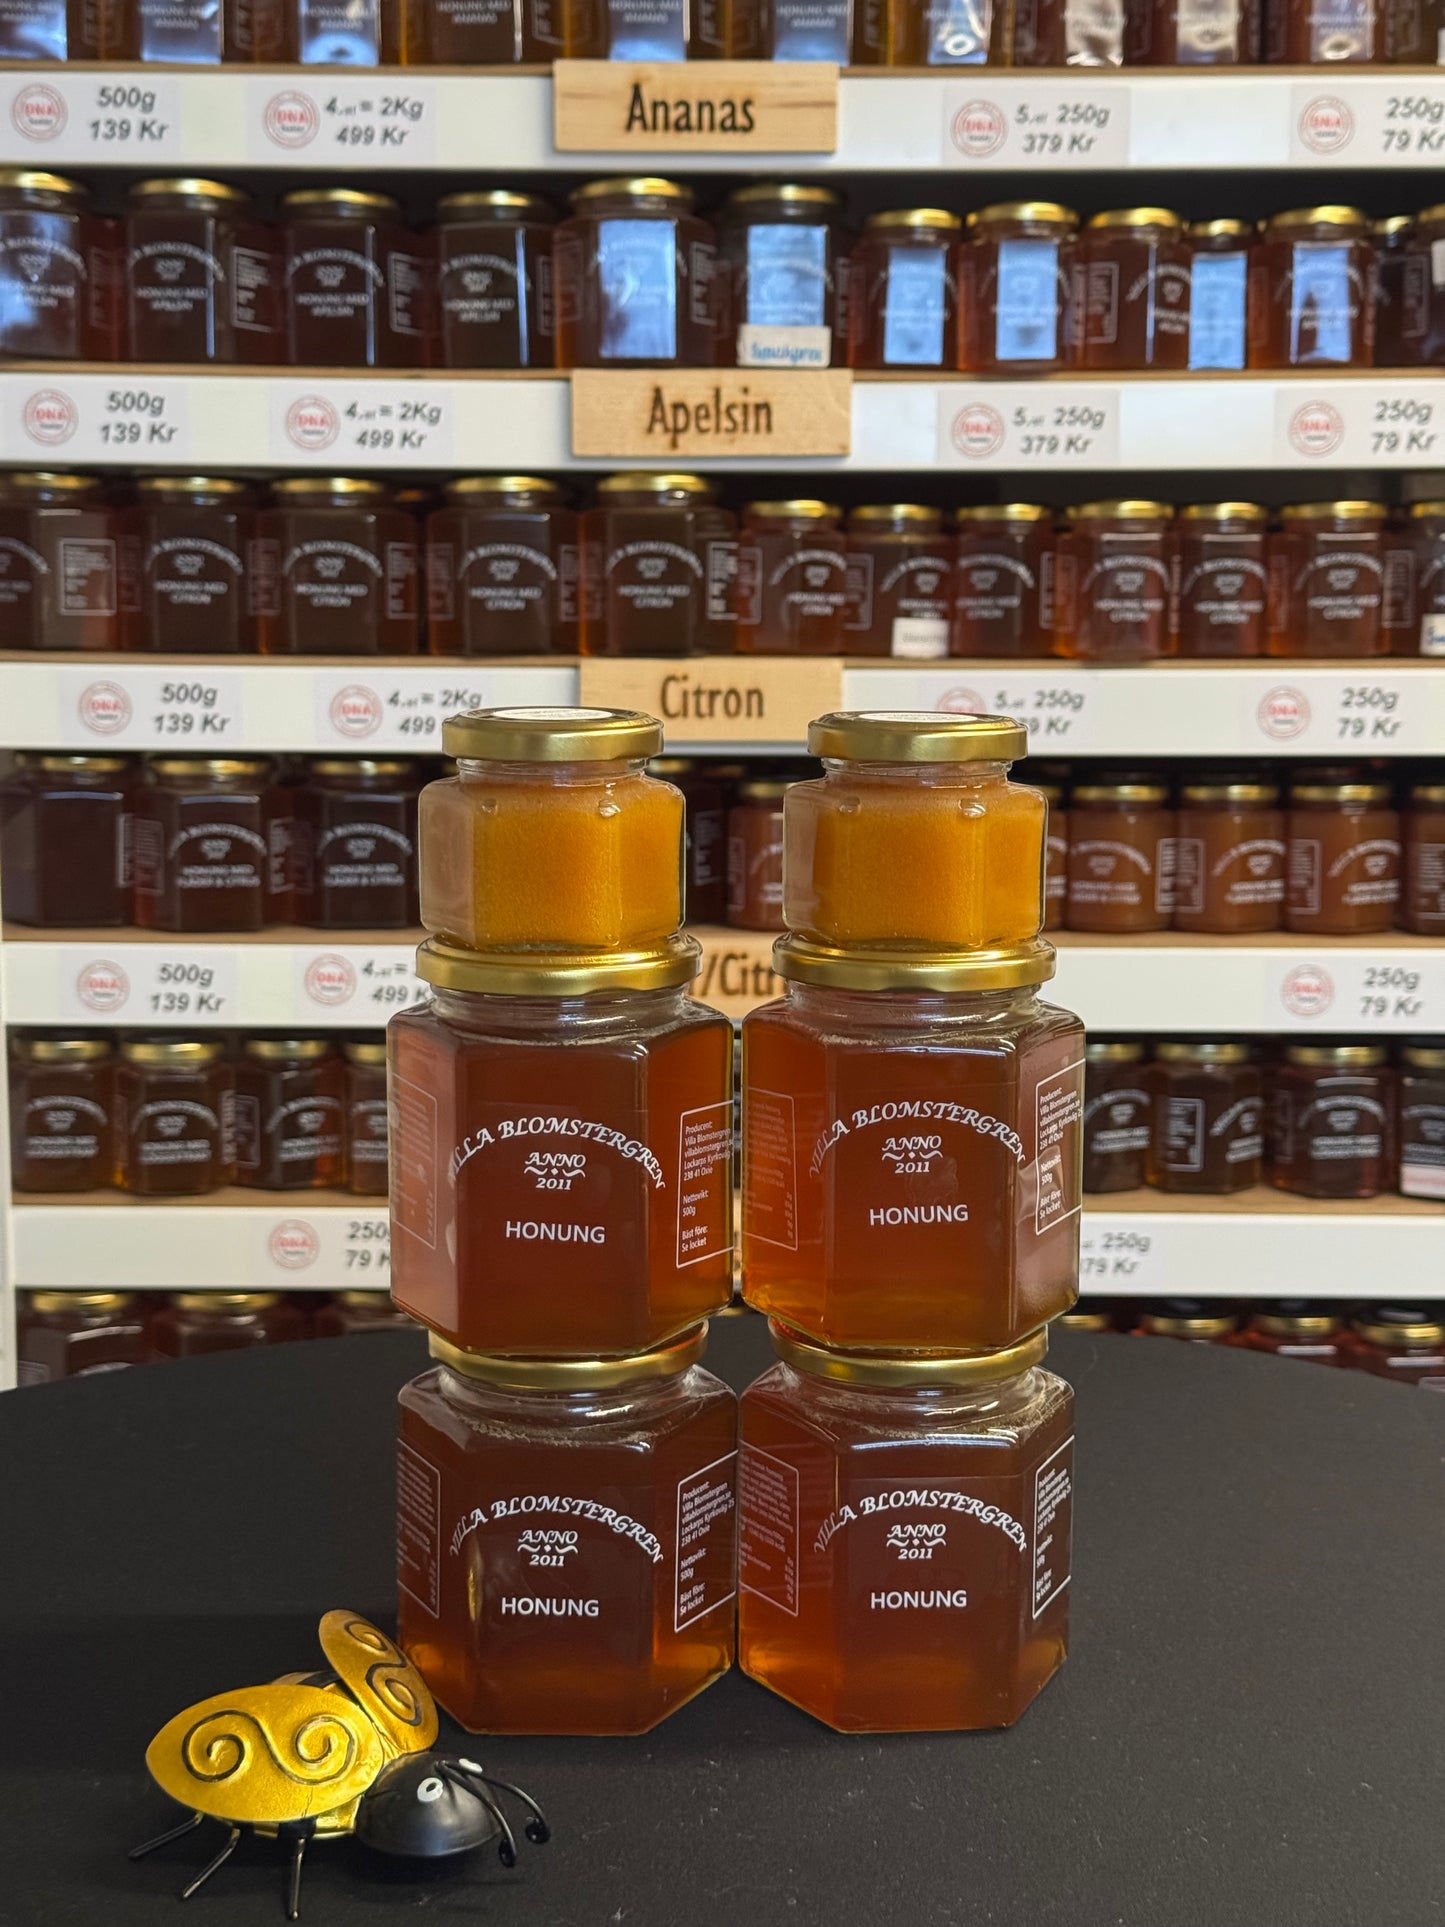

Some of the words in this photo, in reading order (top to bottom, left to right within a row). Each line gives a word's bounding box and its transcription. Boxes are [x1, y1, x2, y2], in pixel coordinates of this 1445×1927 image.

[97, 86, 156, 113] 500g
[381, 96, 424, 121] 2Kg
[626, 82, 756, 133] Ananas
[1385, 97, 1445, 123] 250g
[1057, 103, 1110, 129] 250g
[89, 119, 131, 141] 139
[139, 119, 169, 142] Kr
[335, 126, 375, 147] 499
[381, 126, 410, 147] Kr
[1381, 129, 1411, 151] 79
[1022, 132, 1062, 153] 379
[1067, 132, 1098, 153] Kr
[106, 390, 165, 417] 500g
[399, 402, 442, 425] 2Kg
[1374, 399, 1433, 425] 250g
[645, 386, 774, 450] Apelsin
[1053, 406, 1106, 430] 250g
[100, 422, 141, 444] 139
[149, 422, 178, 443] Kr
[355, 430, 394, 449] 499
[400, 430, 427, 449] Kr
[1370, 431, 1400, 453] 79
[1406, 430, 1438, 452] Kr
[1019, 434, 1059, 455] 379
[1064, 434, 1095, 455] Kr
[161, 683, 218, 708] 500g
[440, 689, 482, 710] 2Kg
[660, 675, 765, 719] Citron
[1034, 690, 1085, 712] 250g
[1341, 686, 1399, 712] 250g
[154, 713, 194, 734] 139
[201, 713, 231, 734] Kr
[399, 715, 436, 735] 499
[1046, 716, 1072, 736] Kr
[1336, 717, 1365, 738] 79
[1370, 716, 1401, 737] Kr
[158, 963, 214, 986] 500g
[1364, 967, 1421, 991] 250g
[150, 992, 190, 1013] 139
[198, 992, 227, 1013] Kr
[372, 985, 408, 1002] 499
[1360, 996, 1387, 1016] 79
[1392, 996, 1423, 1015] Kr
[685, 1136, 696, 1145] Villa
[851, 1100, 1026, 1164] BLOMSTERGREN
[497, 1115, 666, 1190] BLOMSTERGREN
[881, 1135, 942, 1152] ANNO
[524, 1151, 587, 1168] ANNO
[894, 1161, 930, 1175] 2011
[535, 1177, 572, 1191] 2011
[682, 1205, 695, 1218] 500g
[869, 1204, 969, 1226] HONUNG
[504, 1220, 606, 1244] HONUNG
[689, 1236, 706, 1250] locket
[1103, 1232, 1151, 1259] 250g
[346, 1250, 371, 1267] 79
[1113, 1257, 1138, 1274] Kr
[490, 1495, 664, 1564] BLOMSTERGREN
[858, 1489, 1028, 1553] BLOMSTERGREN
[886, 1523, 947, 1539] ANNO
[517, 1529, 579, 1545] ANNO
[528, 1554, 566, 1567] 2011
[897, 1548, 933, 1560] 2011
[501, 1597, 600, 1617] HONUNG
[870, 1589, 968, 1610] HONUNG
